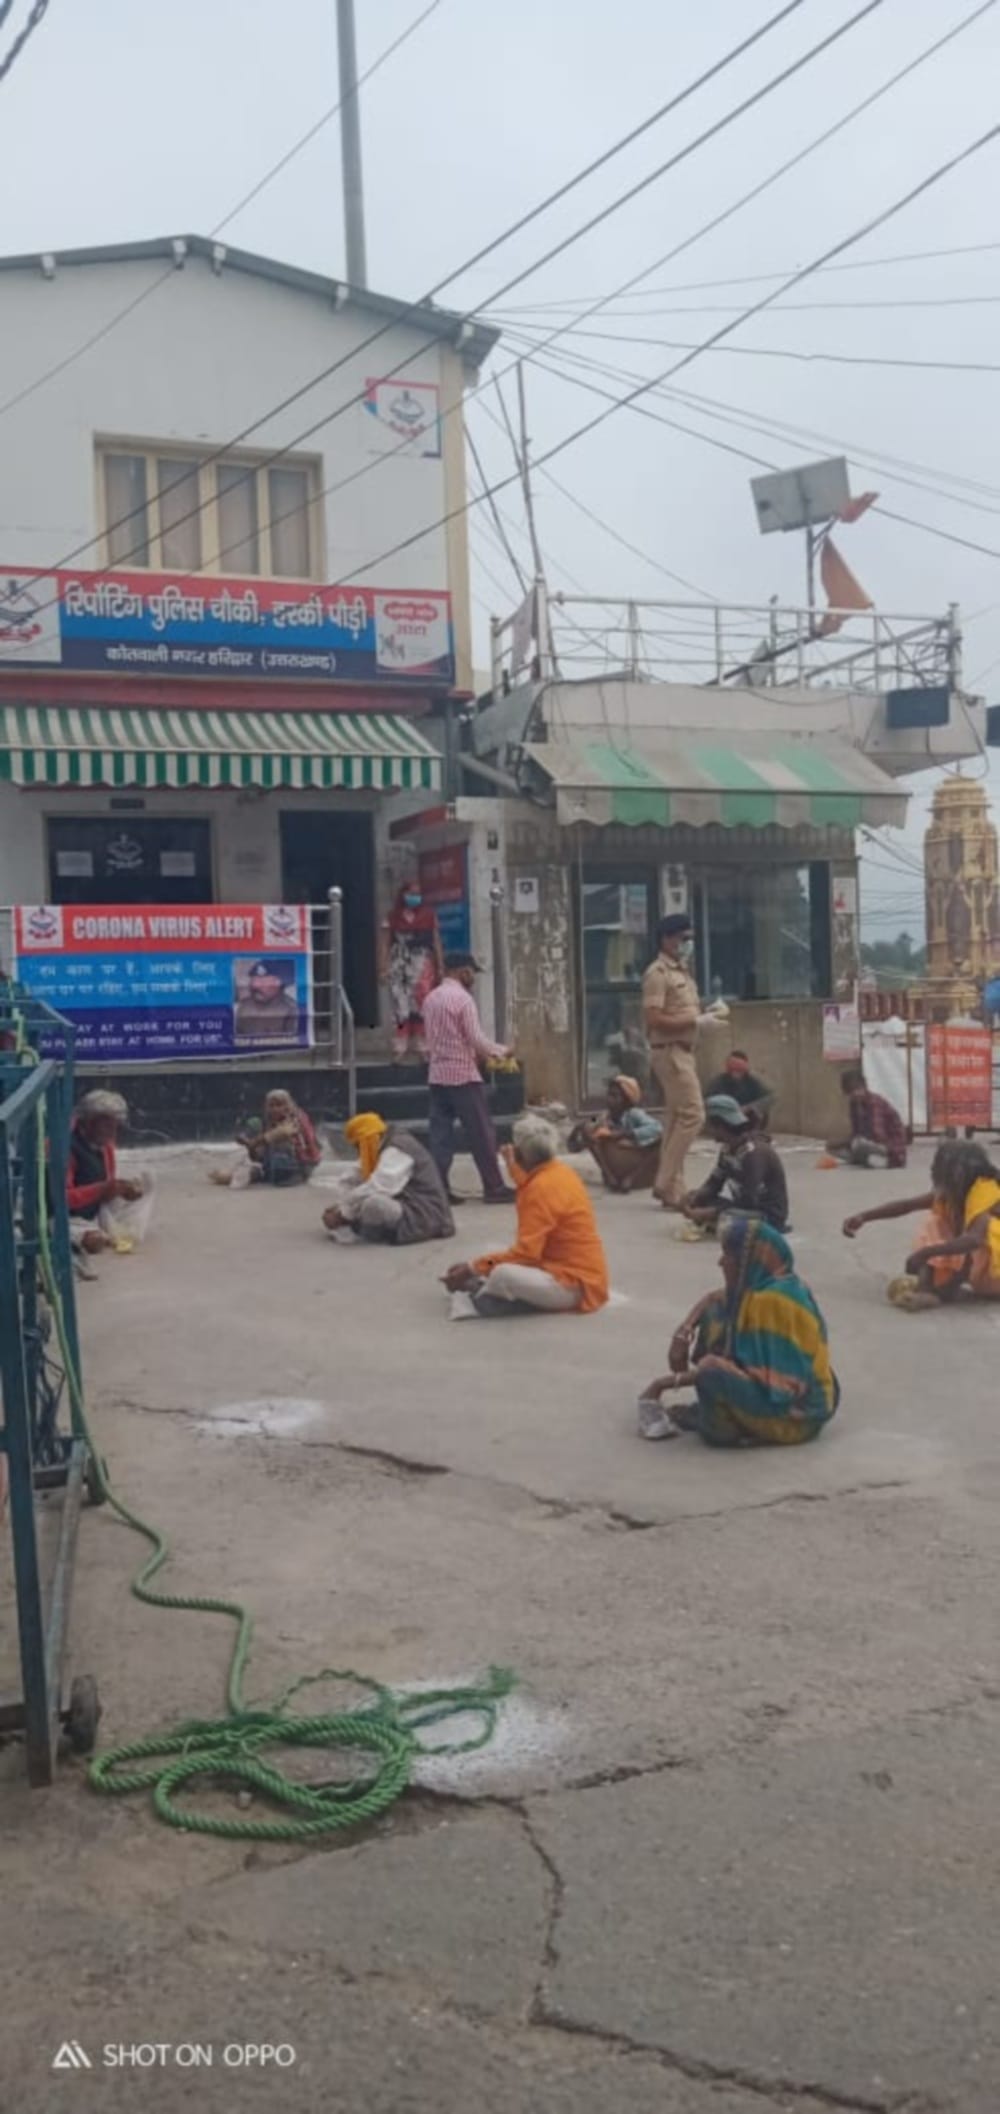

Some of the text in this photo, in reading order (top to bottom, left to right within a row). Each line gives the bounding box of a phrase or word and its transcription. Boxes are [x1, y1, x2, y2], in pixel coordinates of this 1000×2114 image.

[148, 585, 204, 631] पुलिस
[105, 643, 168, 663] कोतवाली
[73, 916, 146, 939] CORONA
[148, 915, 201, 939] VIRUS
[205, 915, 255, 939] ALERT
[100, 1022, 114, 1032] AT
[124, 1021, 158, 1032] WORK
[166, 1021, 190, 1030] FOR
[199, 1020, 222, 1029] YOU
